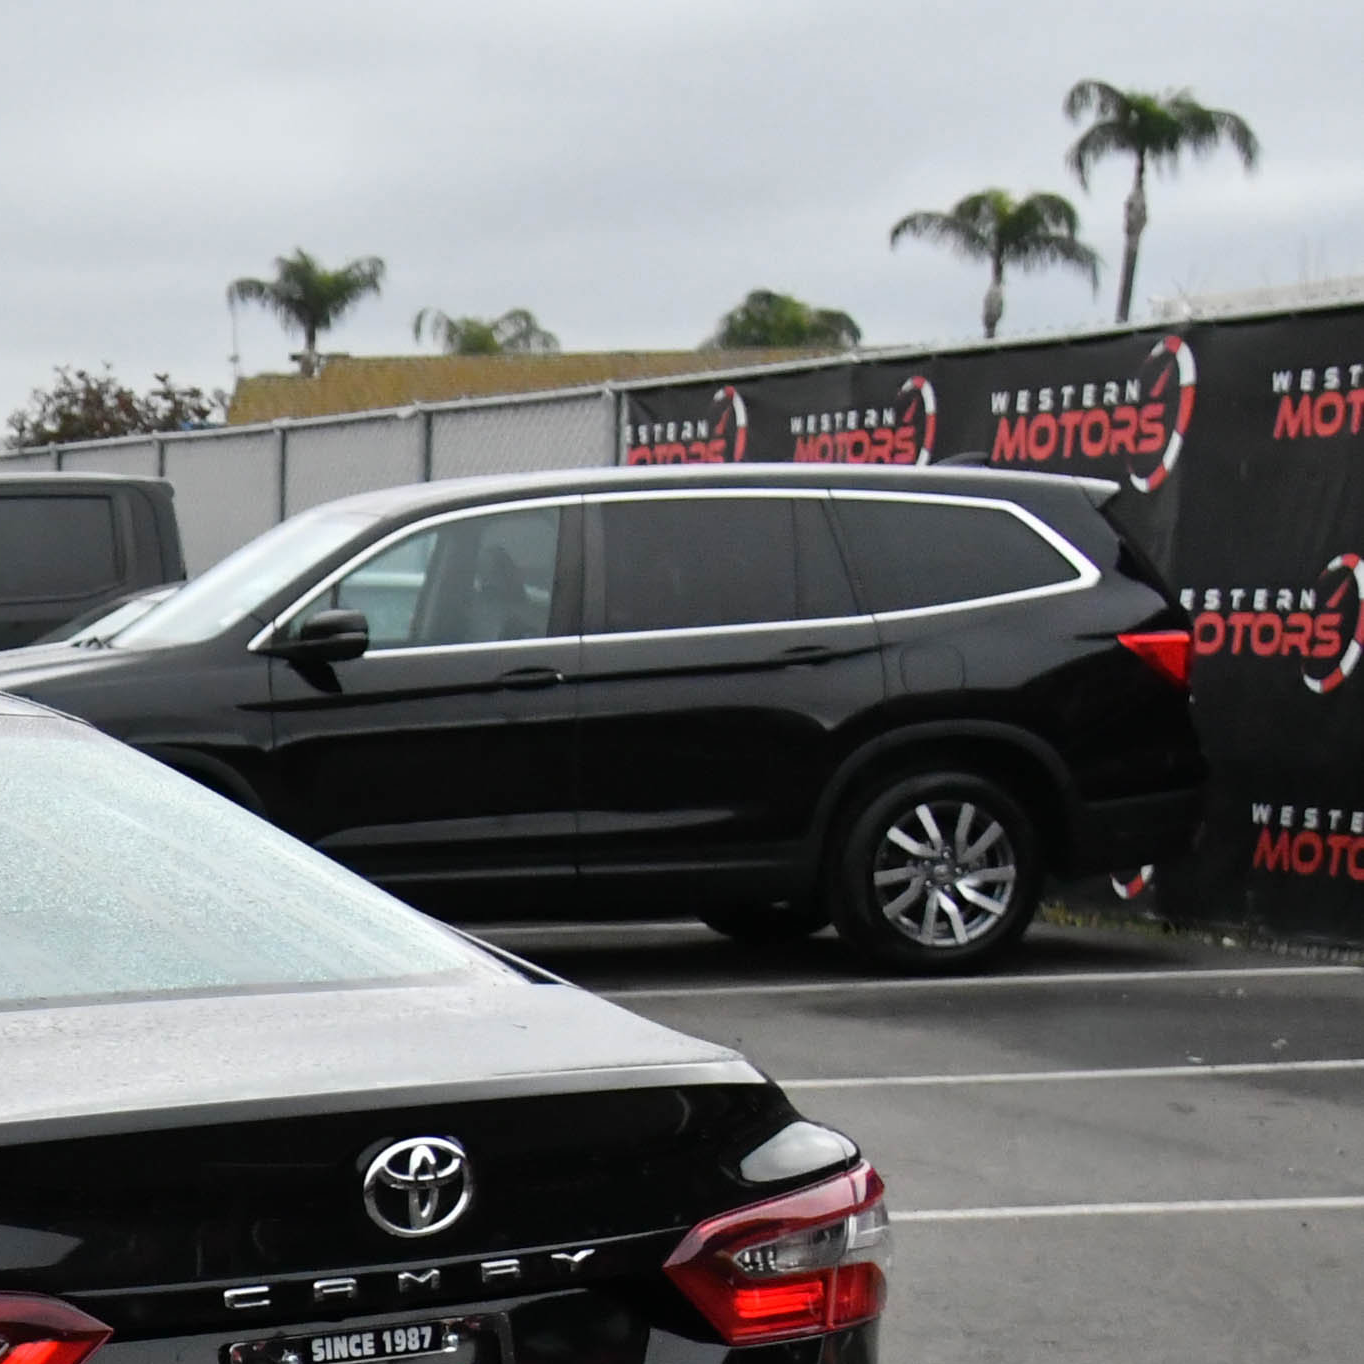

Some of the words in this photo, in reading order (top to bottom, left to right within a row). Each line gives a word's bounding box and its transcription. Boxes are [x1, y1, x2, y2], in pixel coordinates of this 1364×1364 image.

[991, 379, 1141, 414] WESTERN
[625, 419, 710, 445] ESTERN
[790, 407, 896, 434] WESTERN
[991, 402, 1166, 462] MOTORS
[794, 424, 917, 464] MOTORS
[1179, 588, 1316, 611] ESTERN
[1194, 611, 1343, 659] OTORS
[223, 1248, 595, 1310] CAMRY
[312, 1332, 374, 1362] SINCE
[382, 1326, 433, 1353] 1987
